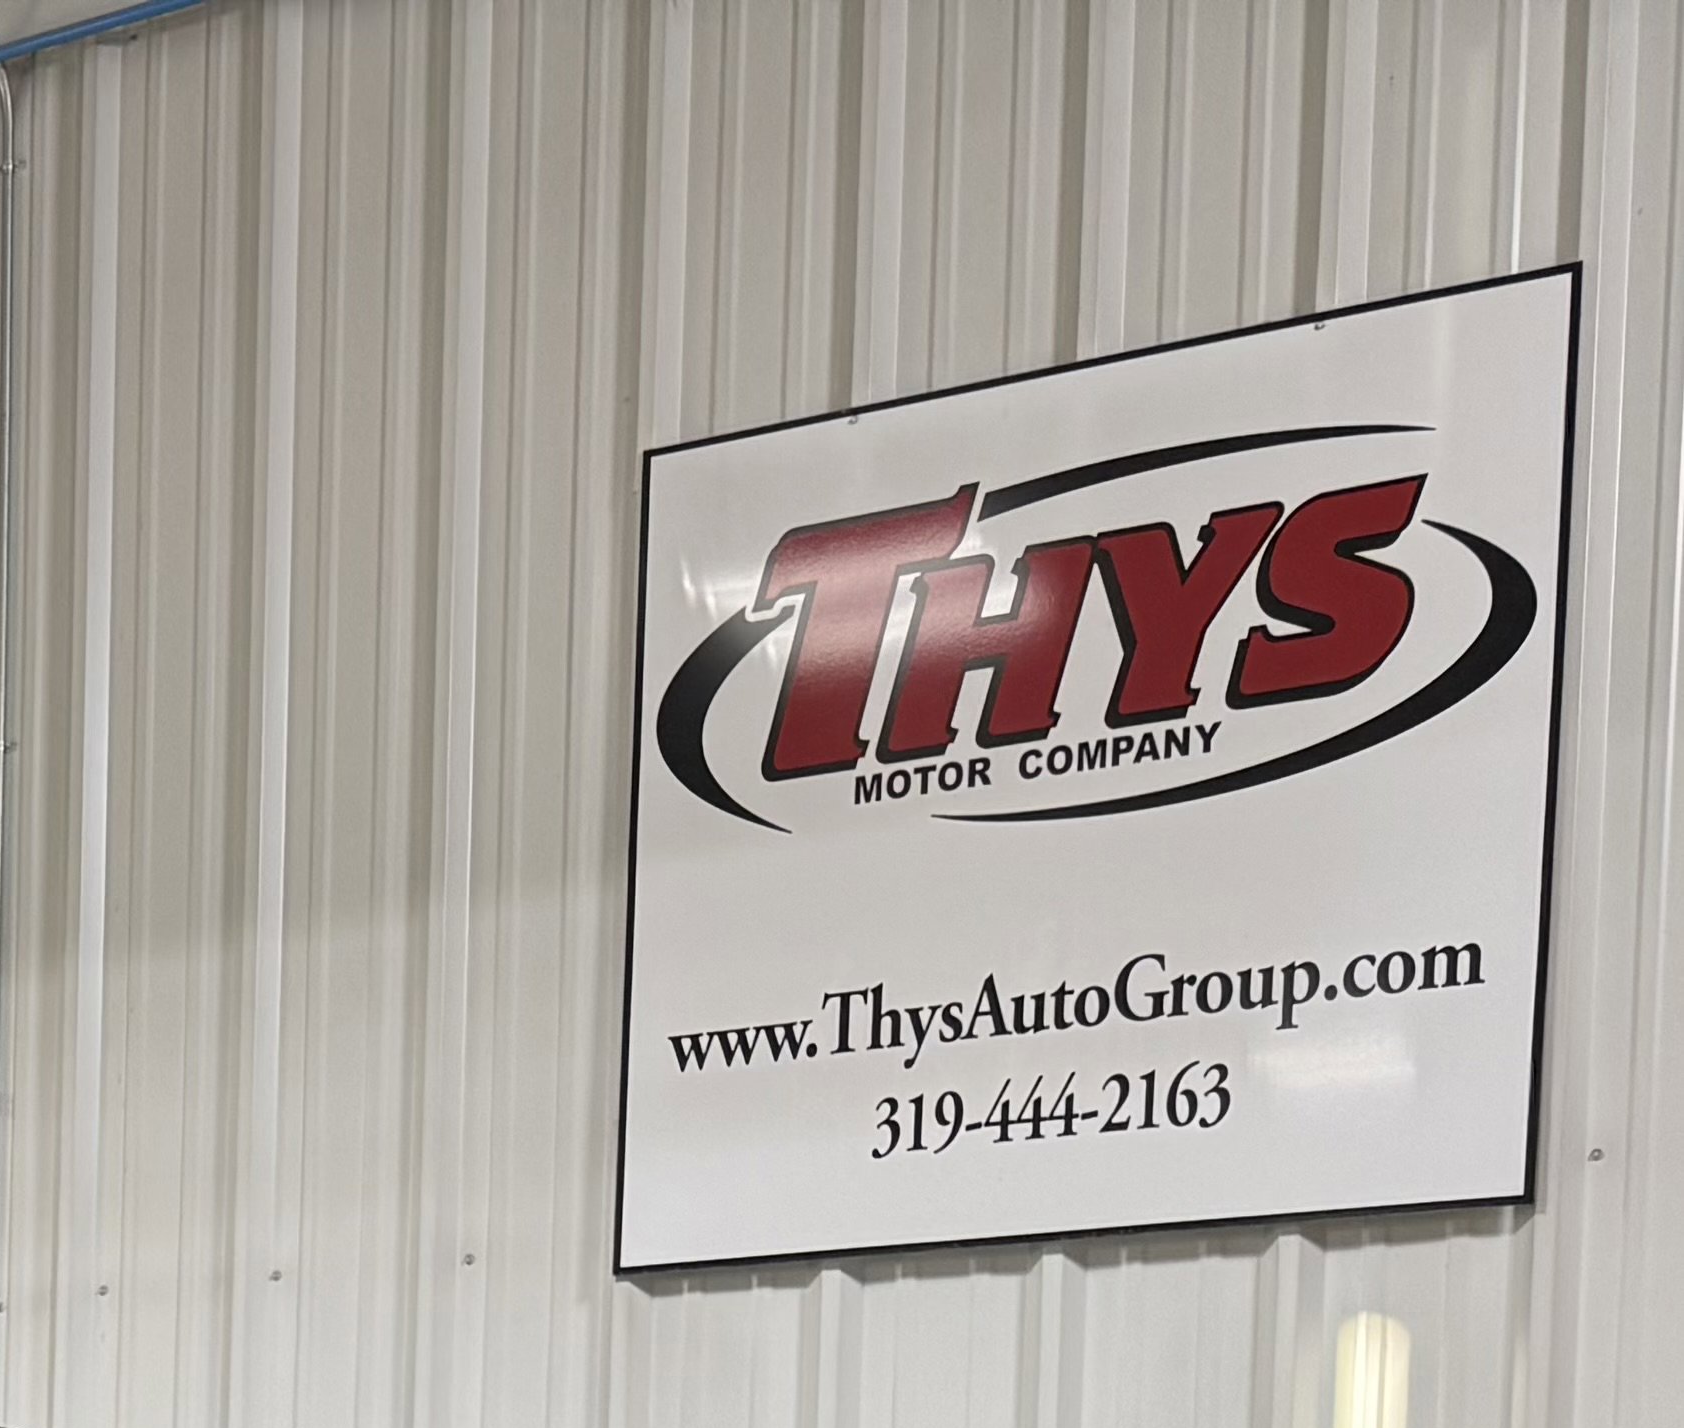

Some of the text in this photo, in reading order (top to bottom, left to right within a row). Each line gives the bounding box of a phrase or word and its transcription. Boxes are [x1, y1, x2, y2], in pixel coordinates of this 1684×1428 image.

[748, 471, 1429, 783] THYS
[853, 721, 1222, 807] MOTOR COMPANY
[668, 940, 1486, 1073] www.ThysAutoGroup.com
[870, 1059, 1234, 1159] 319-444-2163
